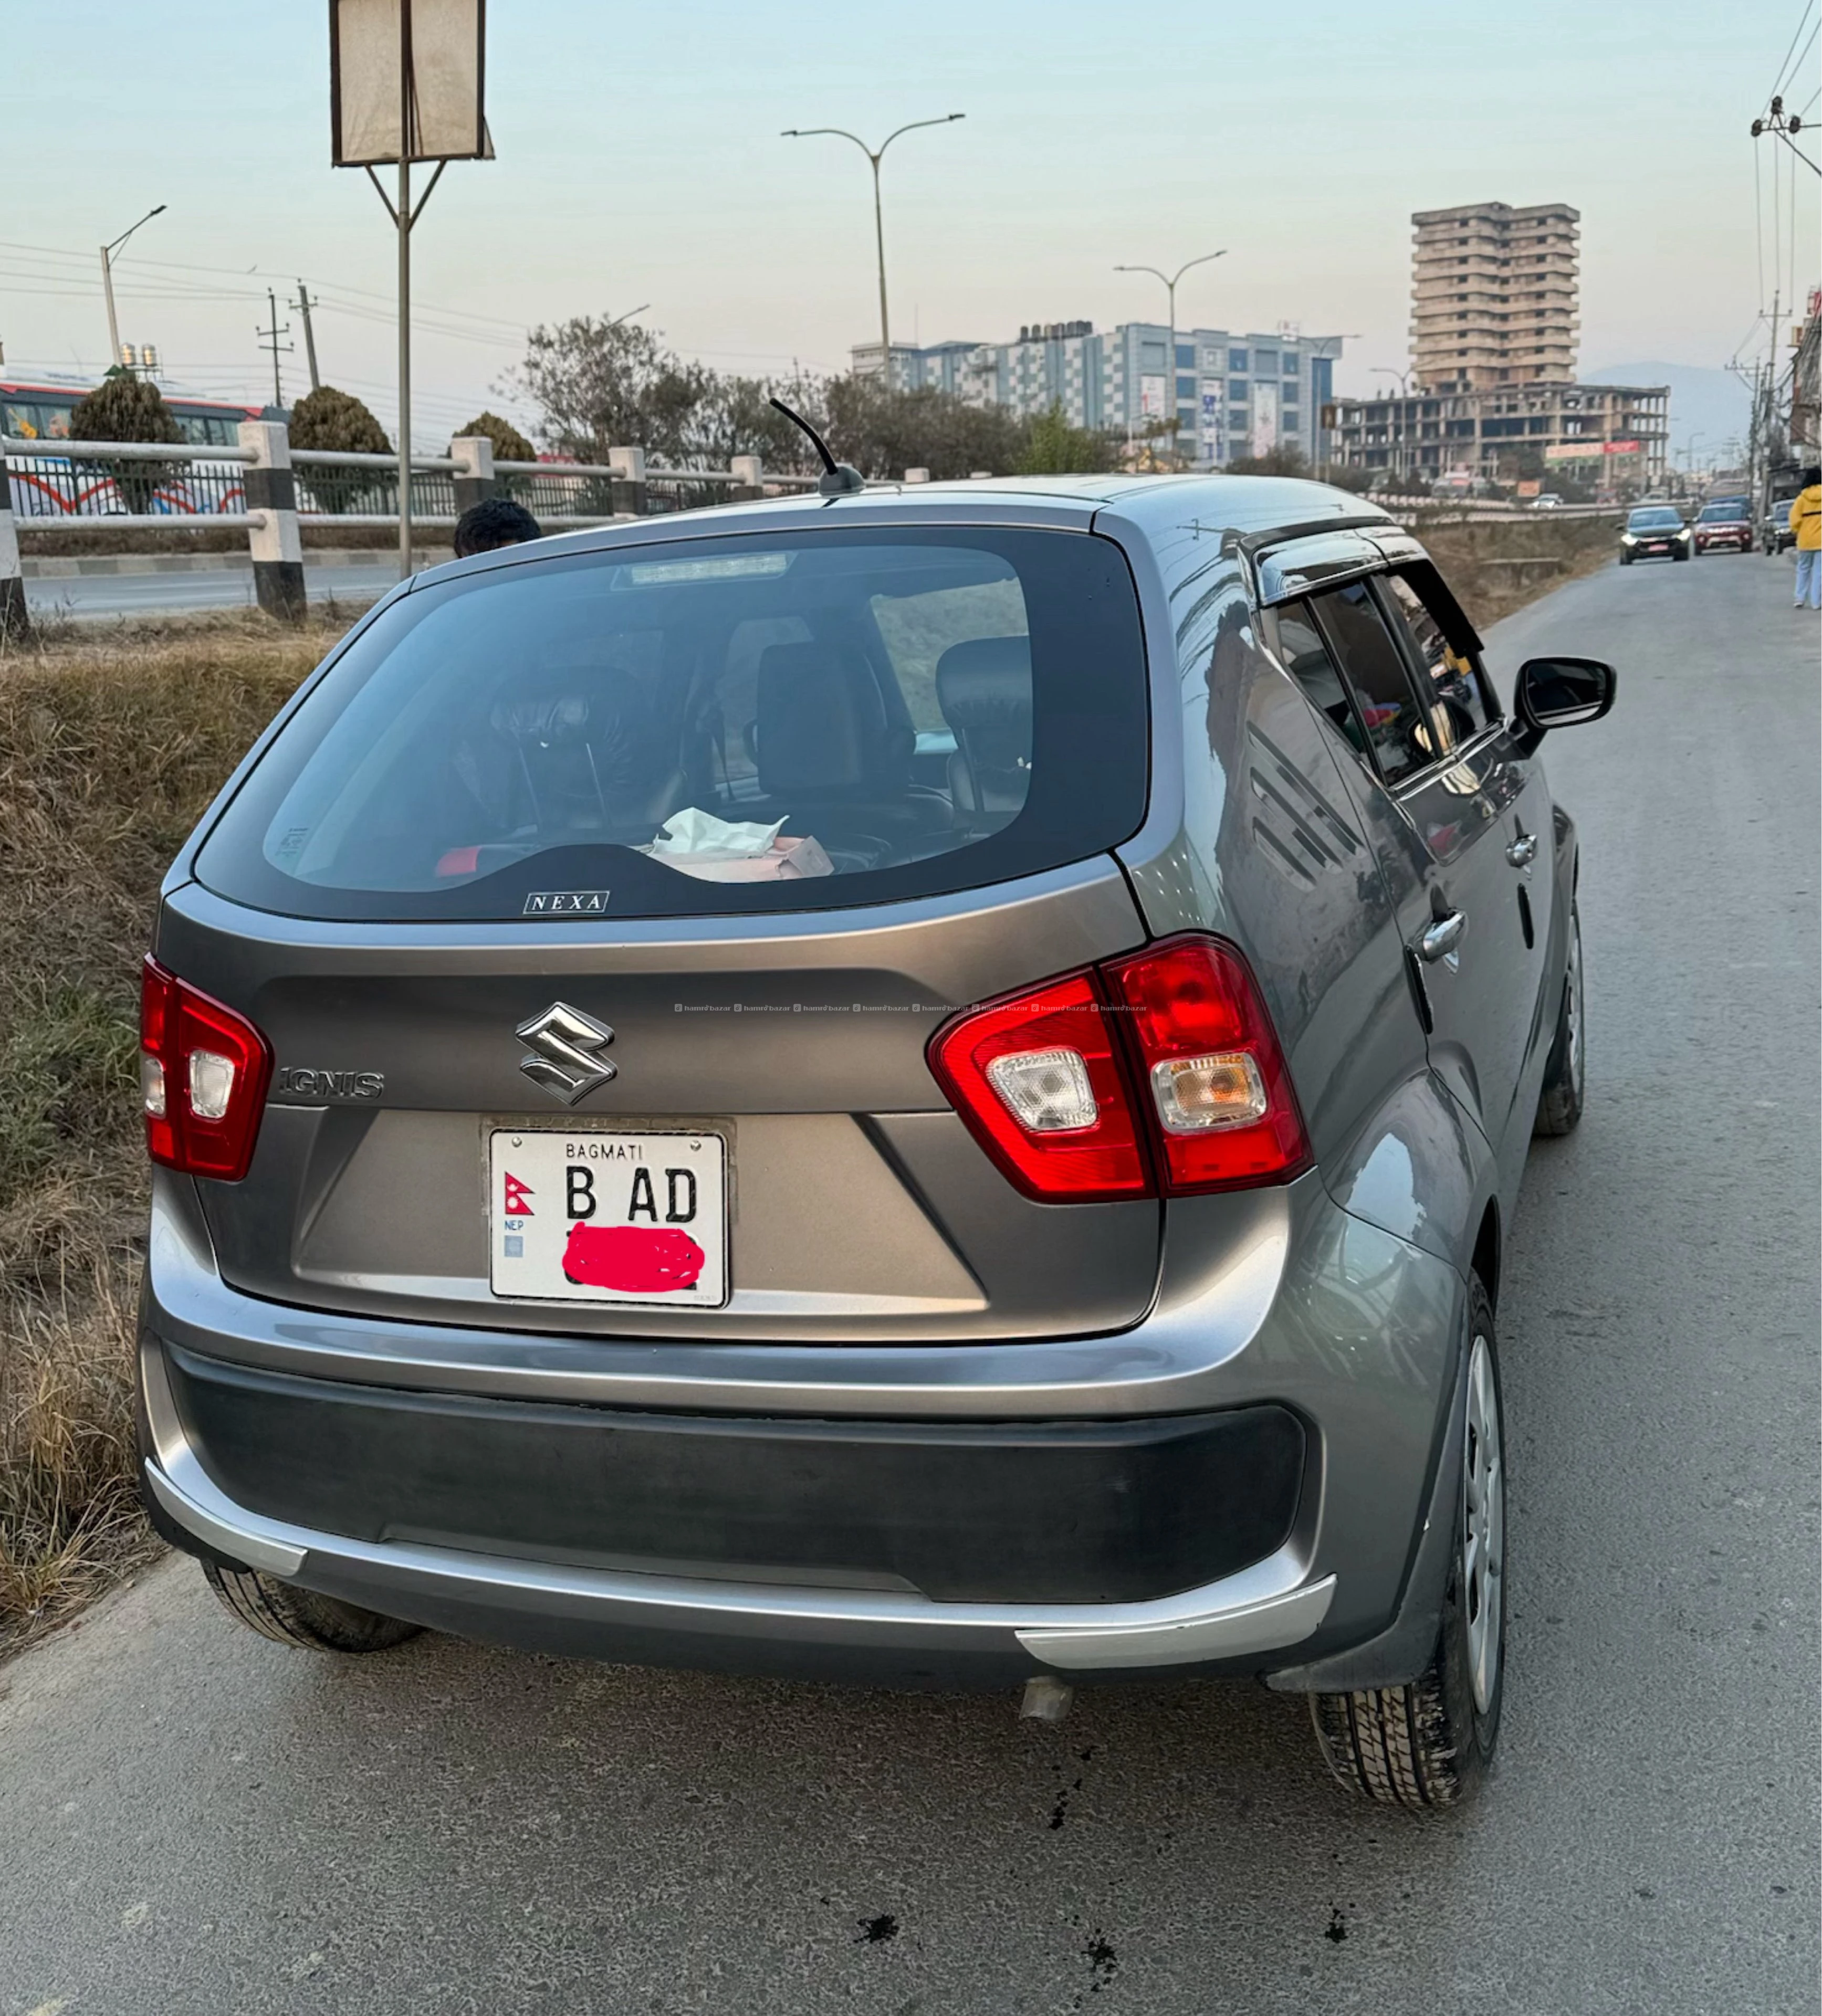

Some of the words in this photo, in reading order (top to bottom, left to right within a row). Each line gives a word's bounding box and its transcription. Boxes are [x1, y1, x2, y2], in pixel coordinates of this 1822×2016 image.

[531, 894, 601, 911] NEXA
[279, 1067, 384, 1100] IGNIS
[566, 1143, 643, 1160] BAGMATI
[566, 1166, 596, 1220] B
[627, 1168, 697, 1223] AD
[504, 1221, 524, 1231] NEP
